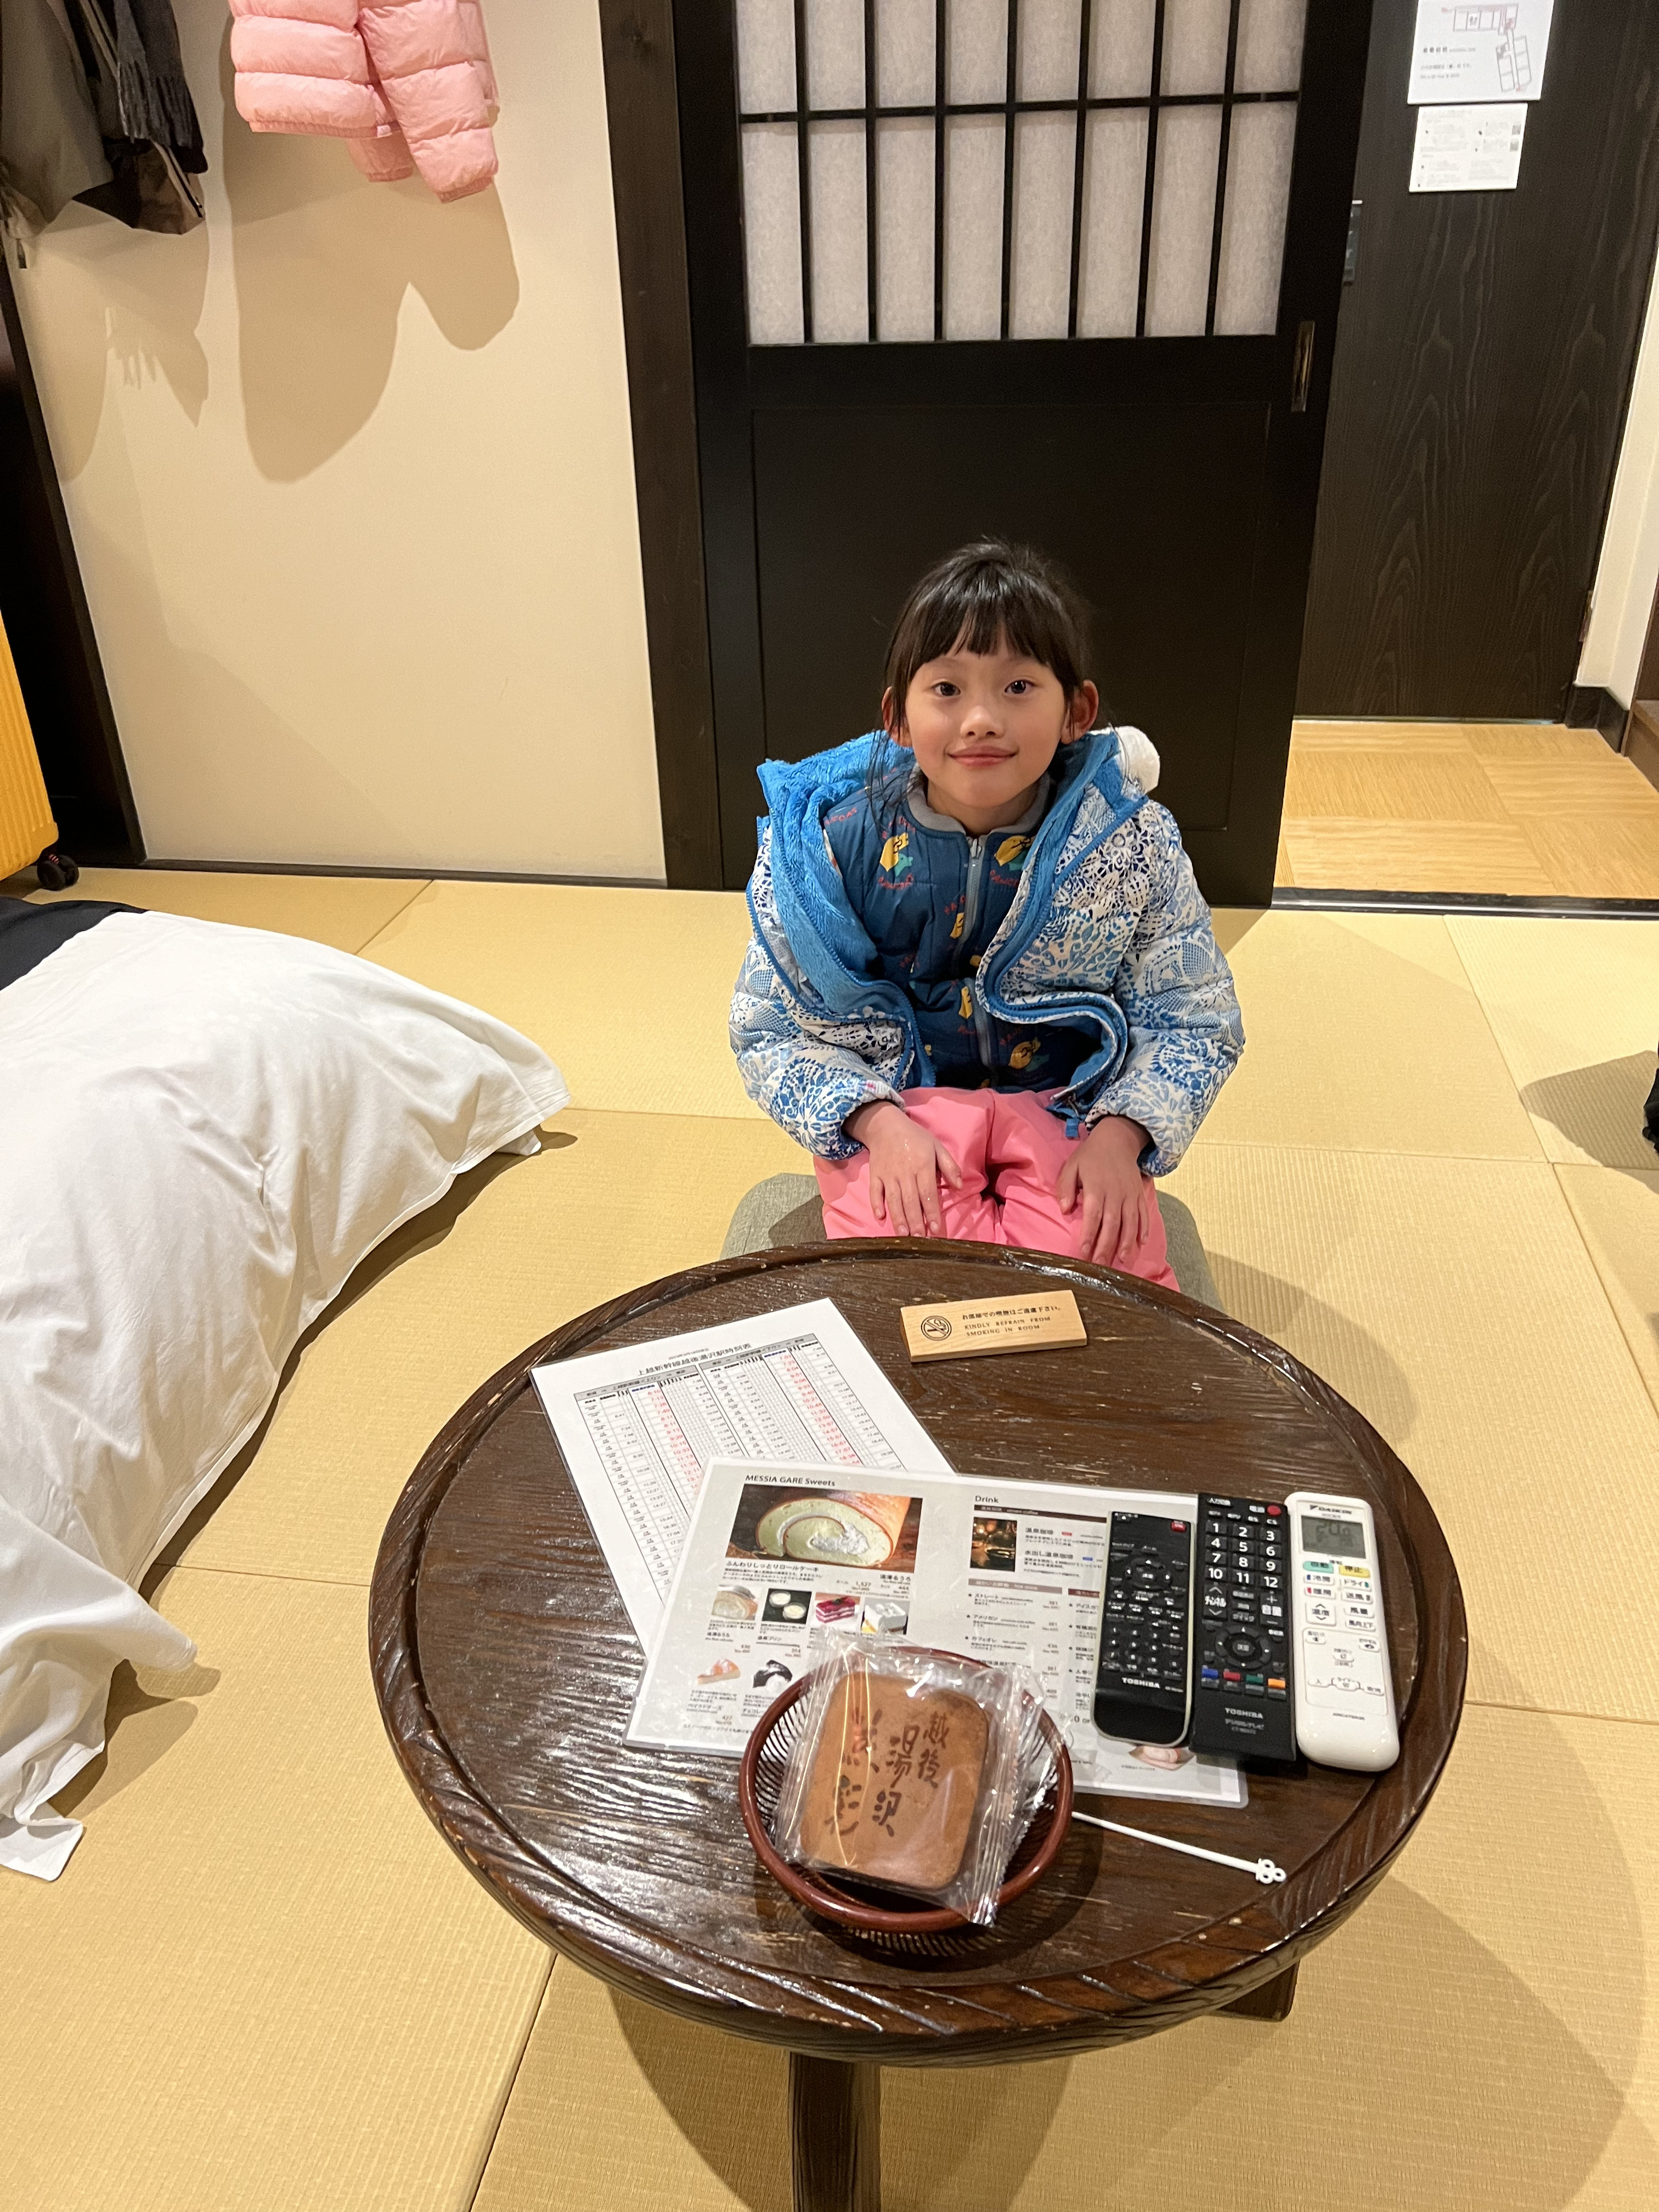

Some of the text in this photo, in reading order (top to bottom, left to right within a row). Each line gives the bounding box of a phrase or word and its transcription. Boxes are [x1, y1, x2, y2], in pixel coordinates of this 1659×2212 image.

[967, 1328, 1000, 1336] SMOKING
[805, 1478, 835, 1487] Sweets
[975, 1495, 999, 1504] Drink
[1213, 1523, 1218, 1532] 1
[1239, 1527, 1248, 1537] 2
[1266, 1531, 1275, 1541] 3
[1211, 1538, 1221, 1548] 4
[1239, 1542, 1248, 1552] 5
[1266, 1546, 1275, 1556] 6
[1212, 1553, 1221, 1562] 7
[1239, 1557, 1248, 1567] 8
[1266, 1561, 1276, 1571] 9
[1209, 1568, 1223, 1579] 10
[1236, 1572, 1249, 1584] 11
[1263, 1576, 1278, 1588] 12
[1122, 1677, 1160, 1689] TOSHIBA
[1224, 1707, 1263, 1719] TOSHIBA
[918, 1711, 950, 1788] 越後
[872, 1724, 921, 1837] 湯沢
